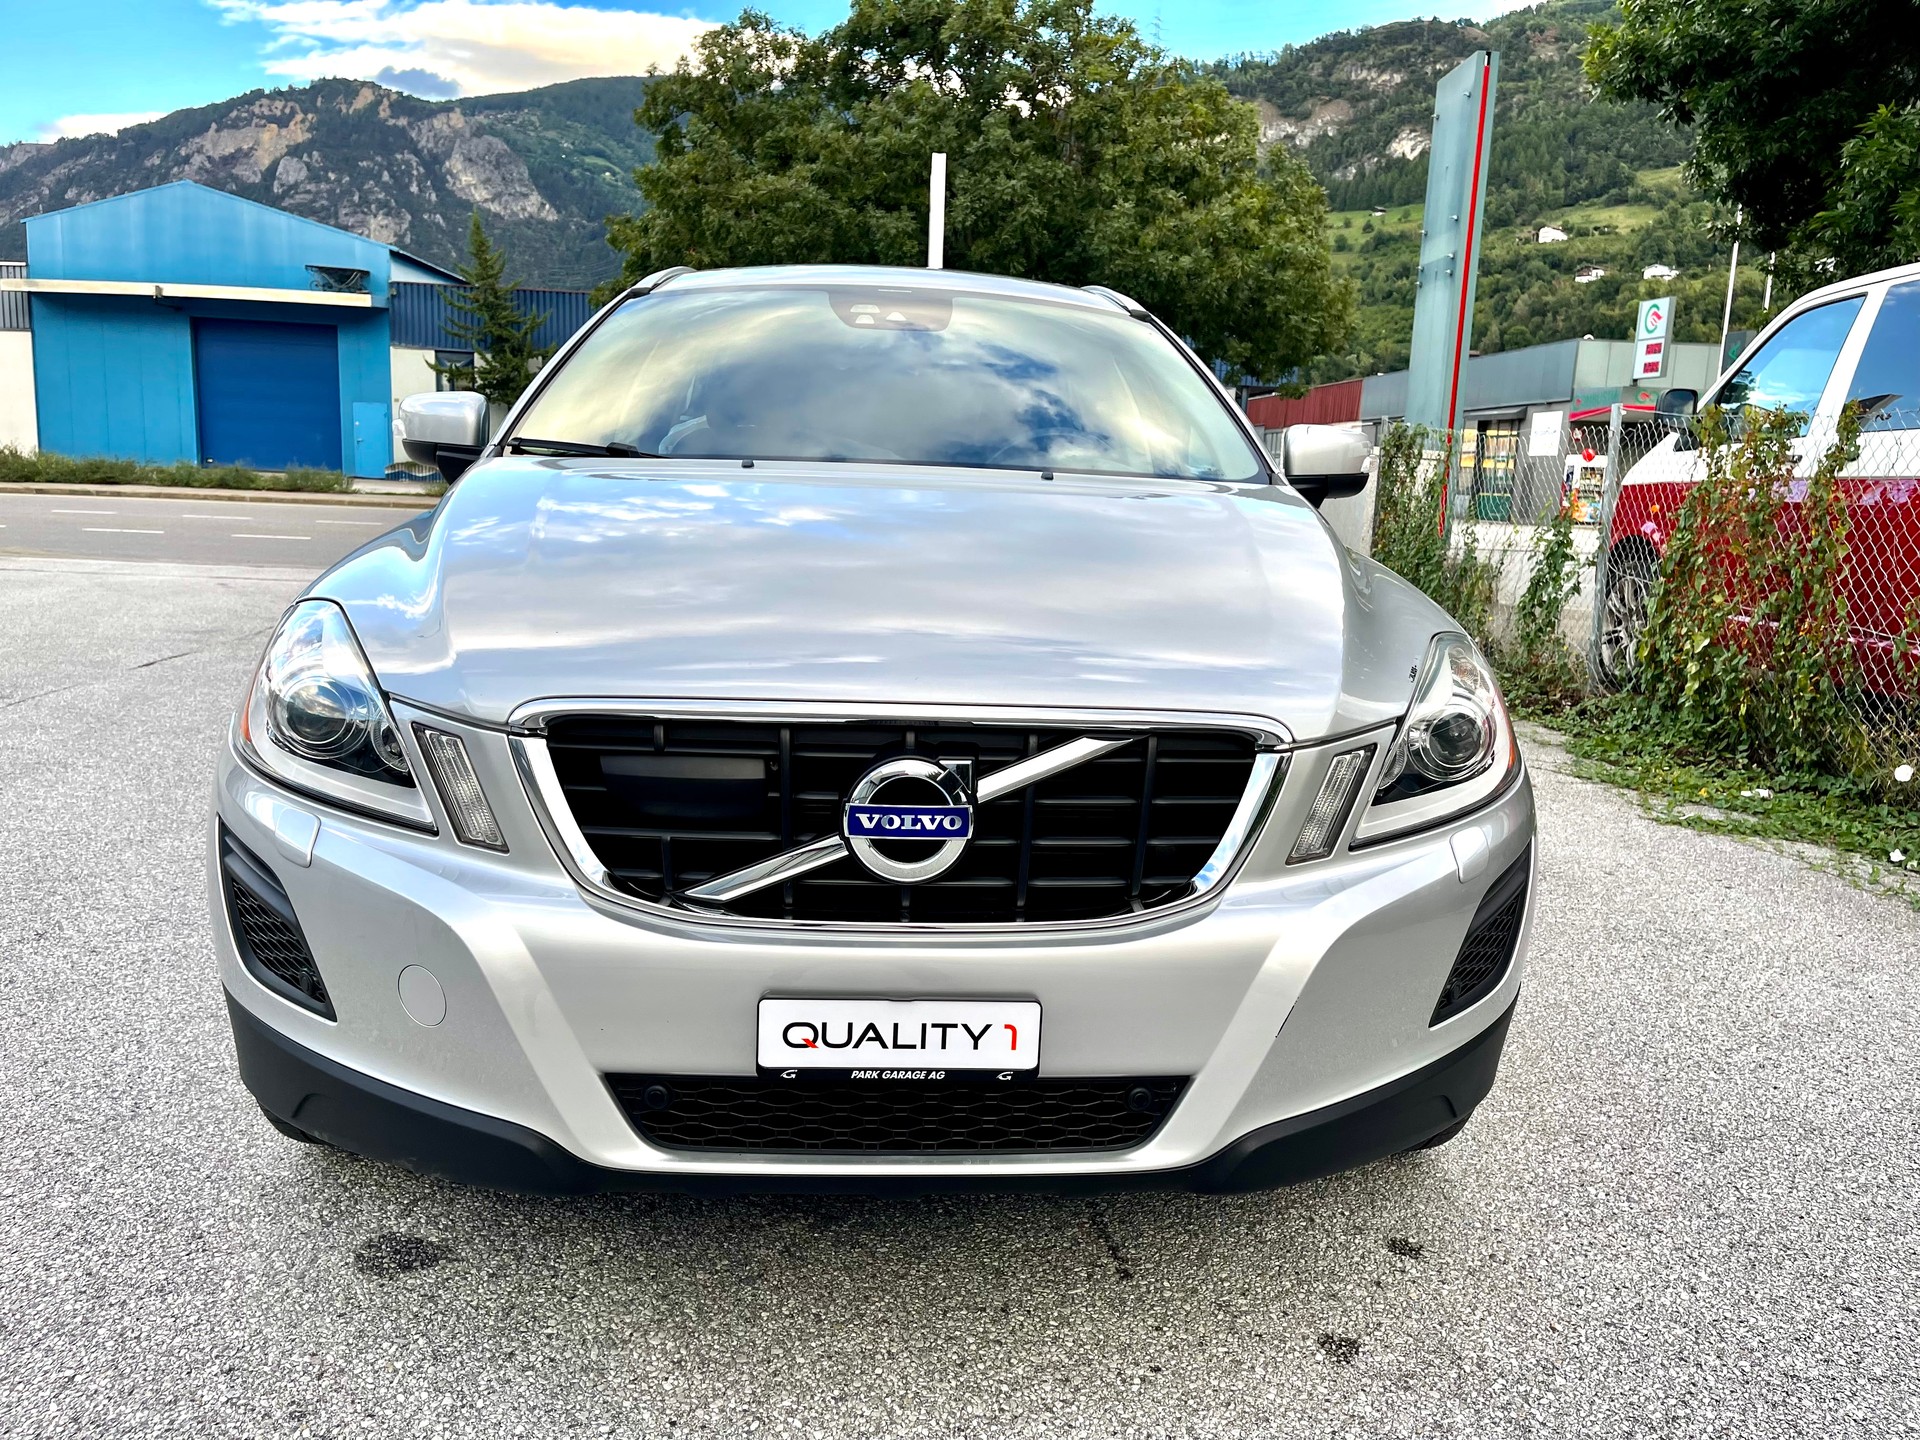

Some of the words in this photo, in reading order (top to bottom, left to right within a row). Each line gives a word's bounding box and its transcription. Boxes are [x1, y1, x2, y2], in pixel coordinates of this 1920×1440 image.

[855, 813, 962, 830] VOLVO
[782, 1022, 993, 1050] QUALITY
[1004, 1024, 1017, 1050] 1
[851, 1070, 880, 1079] PARK
[882, 1070, 927, 1080] GARAGE
[928, 1071, 945, 1080] AG
